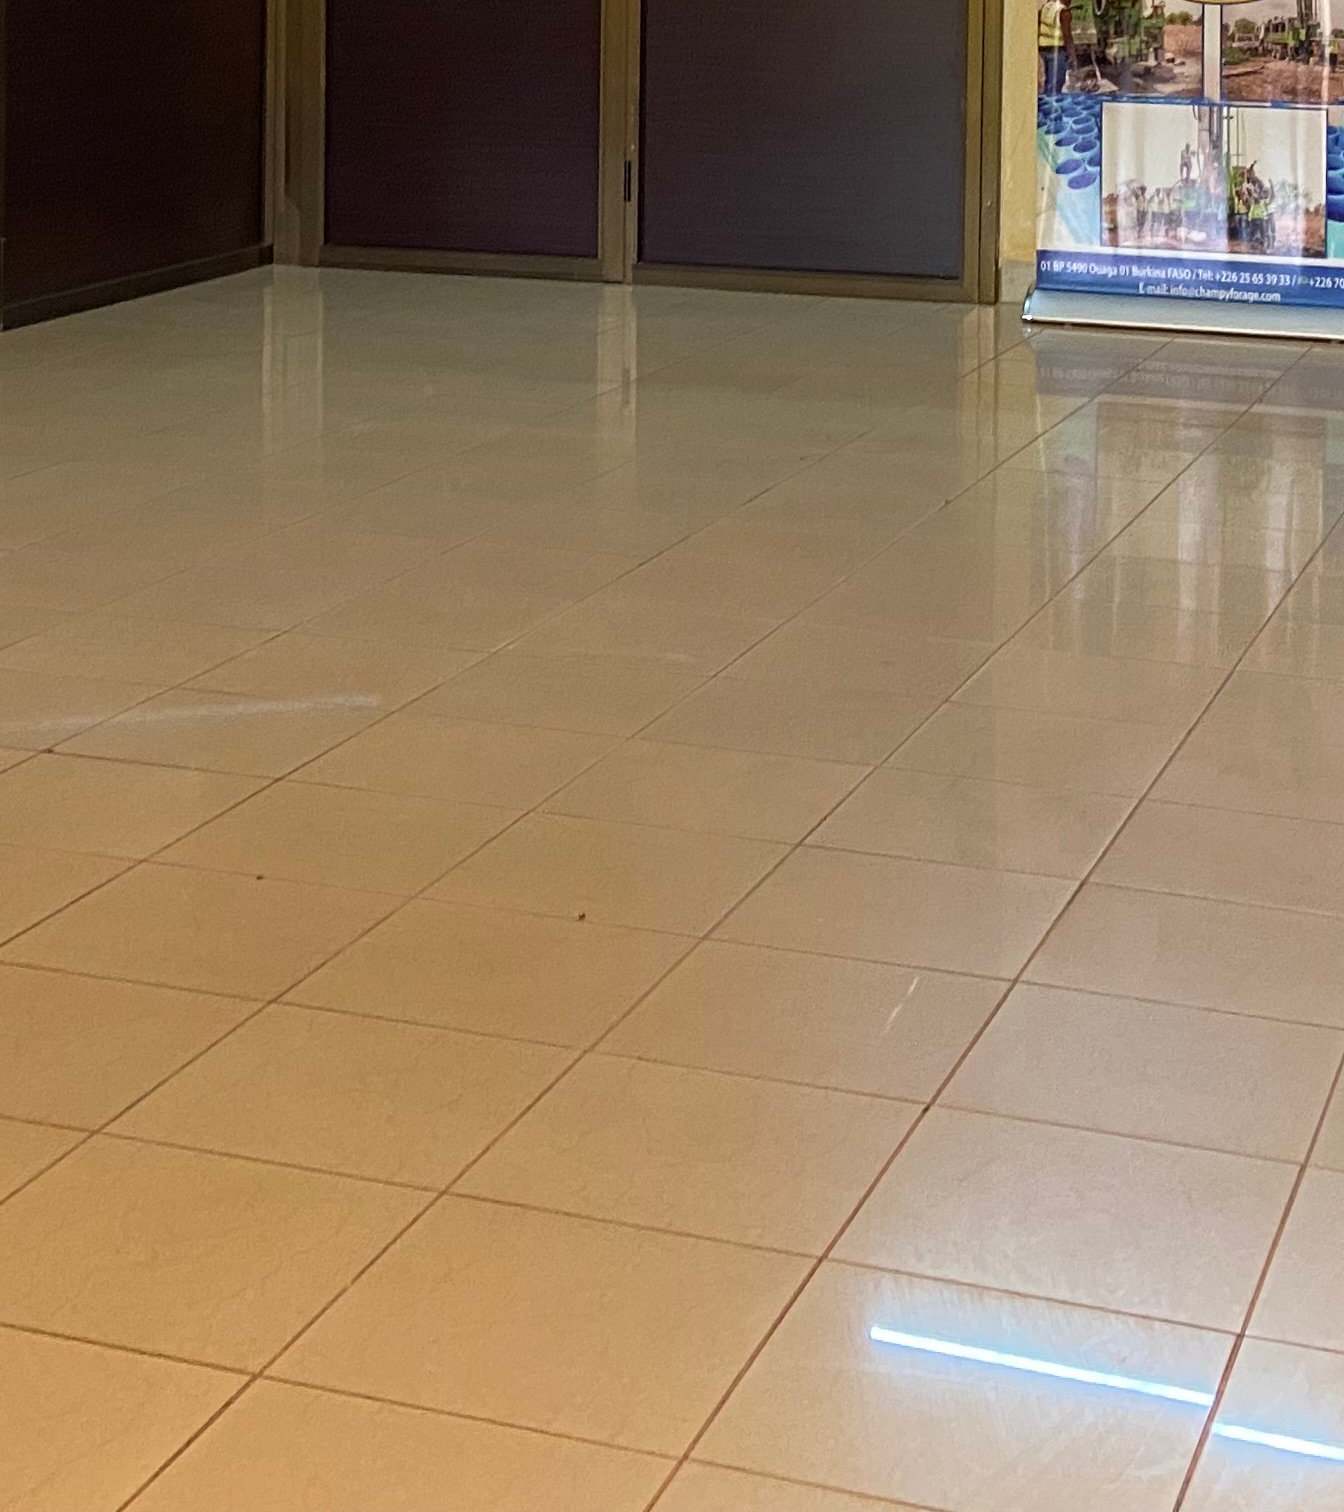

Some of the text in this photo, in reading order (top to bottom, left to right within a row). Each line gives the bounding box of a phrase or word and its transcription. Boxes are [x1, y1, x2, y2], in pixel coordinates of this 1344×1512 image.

[1040, 260, 1050, 272] 01
[1119, 265, 1129, 276] 01
[1168, 267, 1191, 280] FASO
